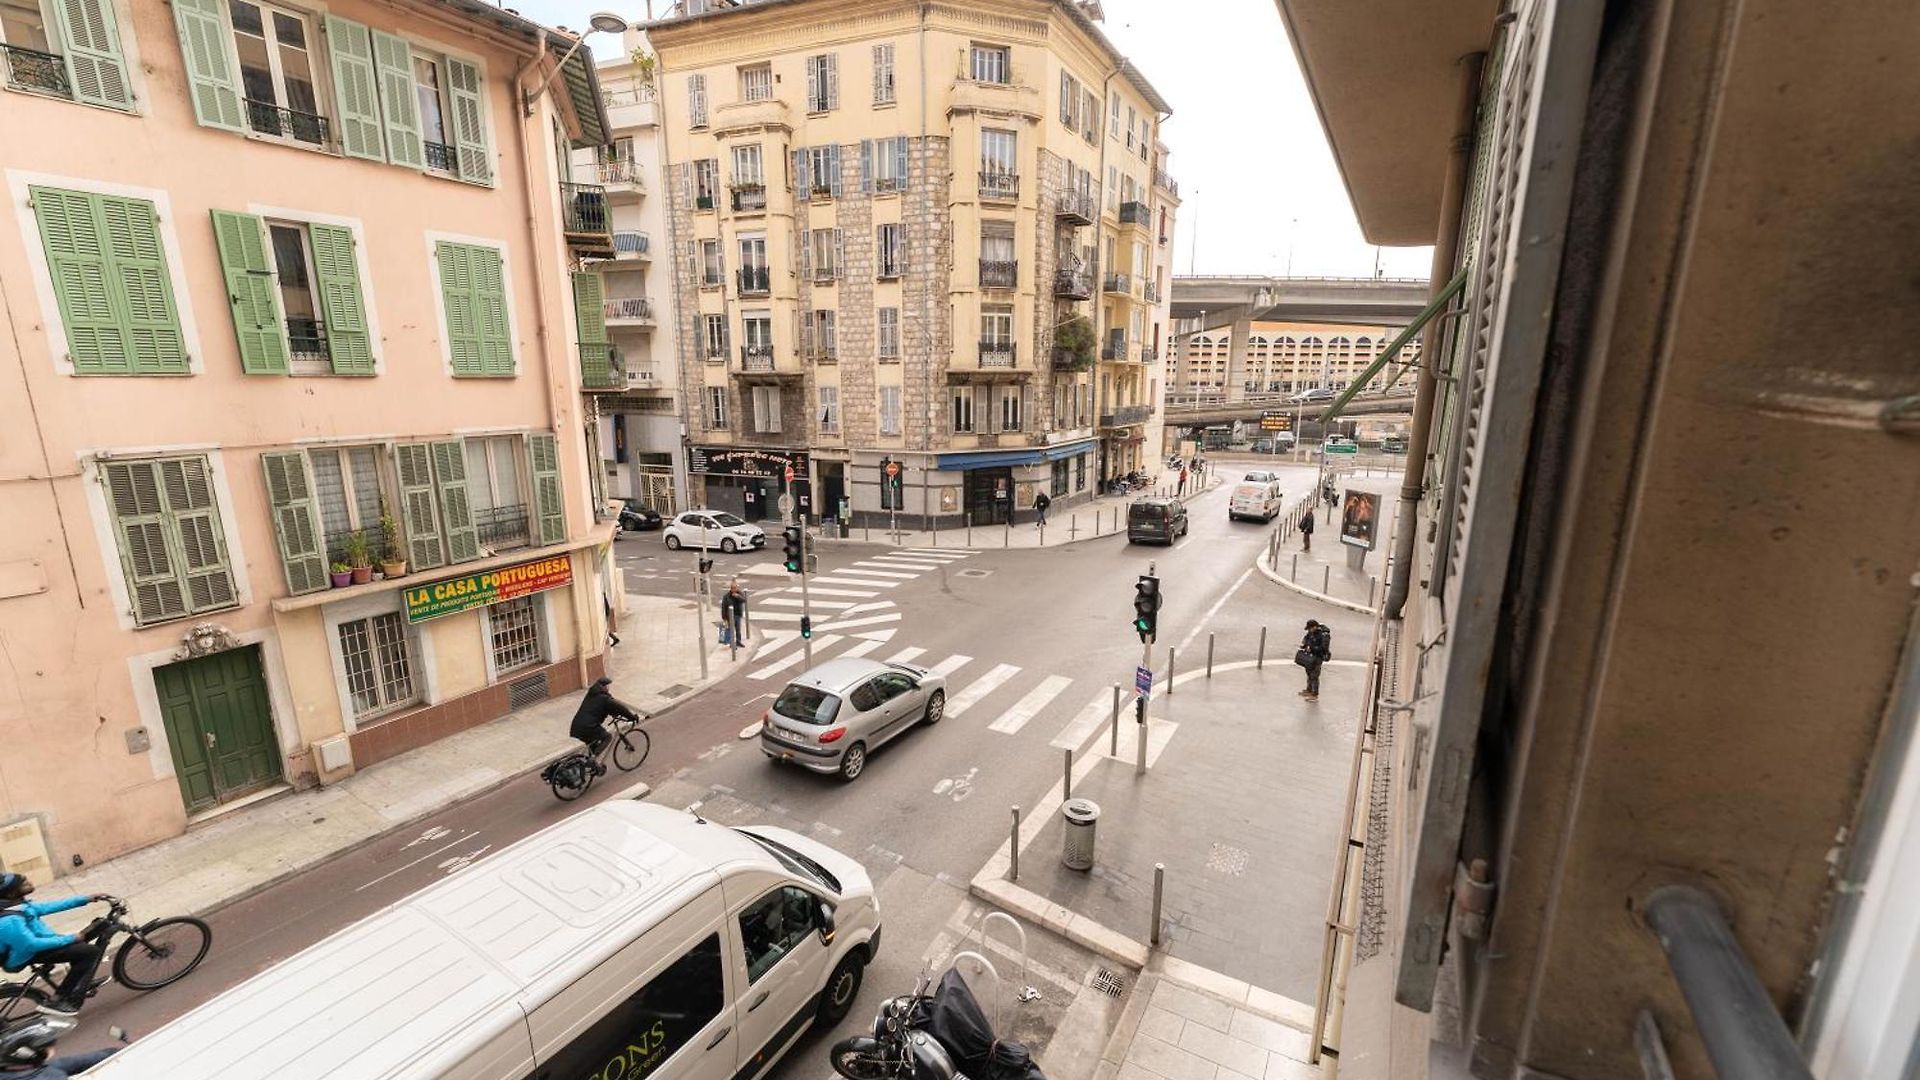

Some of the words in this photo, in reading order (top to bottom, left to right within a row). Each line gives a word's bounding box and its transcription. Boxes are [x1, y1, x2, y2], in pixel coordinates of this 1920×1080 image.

[408, 589, 431, 606] LA
[435, 578, 477, 600] CASA
[481, 558, 569, 589] PORTUGUESA
[588, 1020, 665, 1080] ONS
